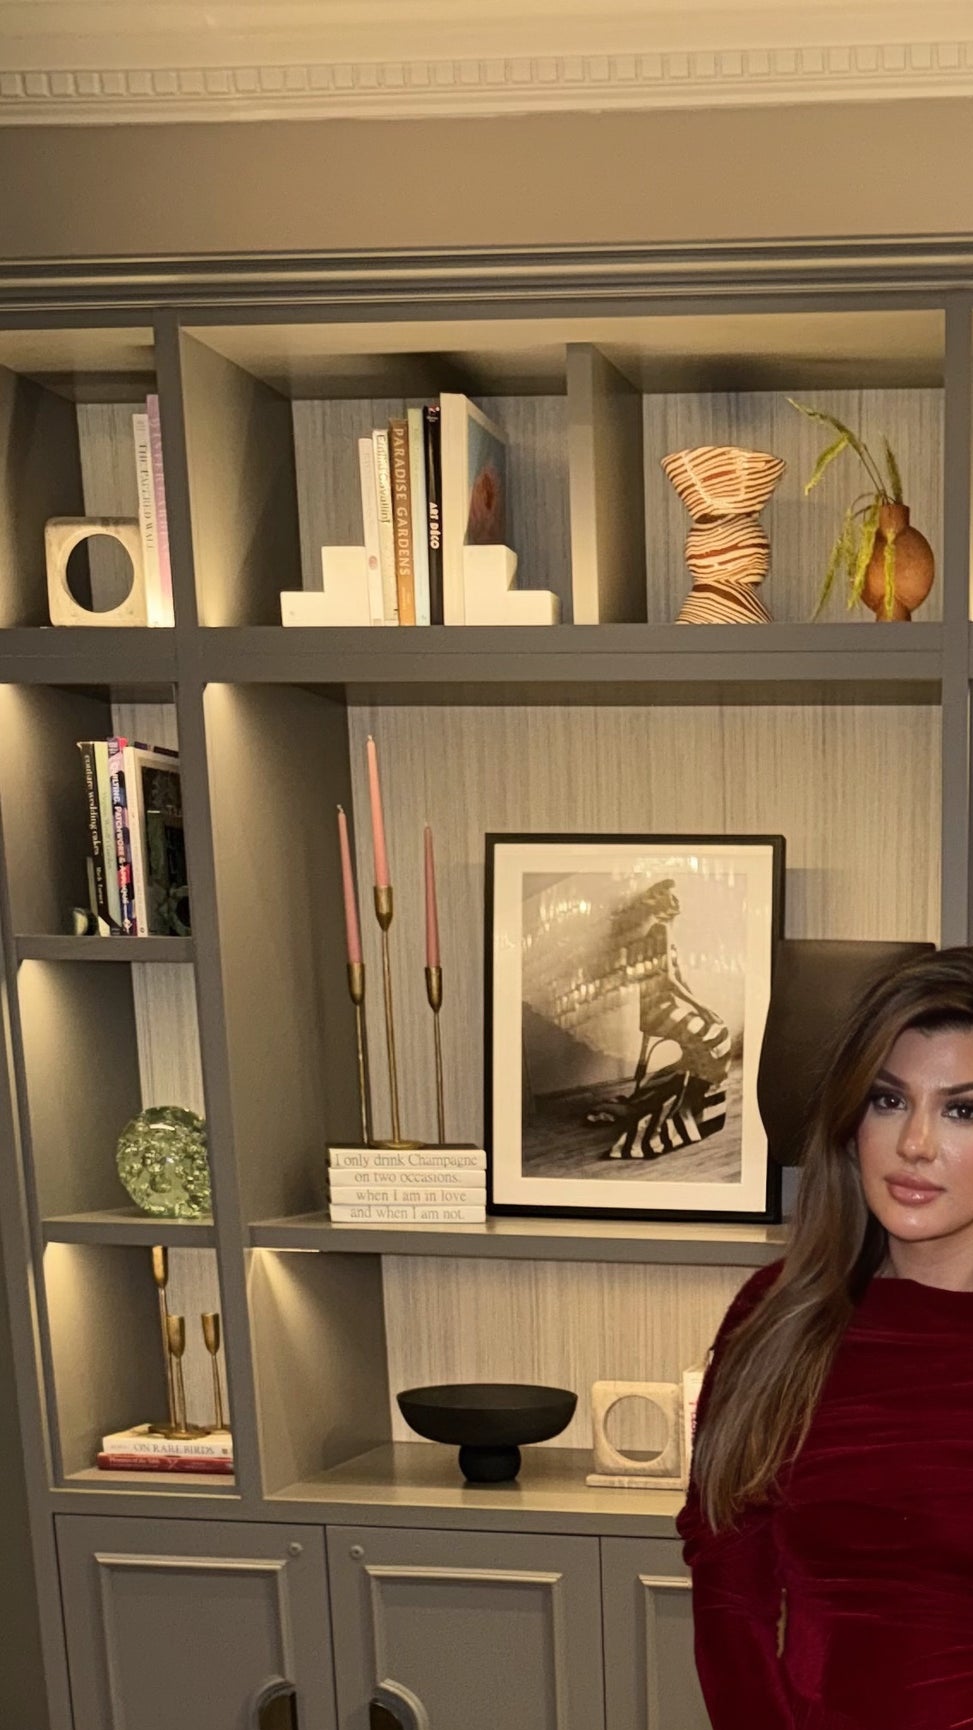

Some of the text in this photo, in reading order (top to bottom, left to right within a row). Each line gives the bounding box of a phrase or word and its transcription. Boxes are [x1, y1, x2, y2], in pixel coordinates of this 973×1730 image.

[139, 444, 148, 463] THE
[392, 428, 411, 576] PARADISE GARDENS
[429, 502, 439, 520] ART
[88, 791, 98, 830] wedding
[114, 806, 125, 856] PATCHWORK
[92, 831, 101, 856] cakes
[335, 1154, 478, 1168] I only drink Champagne
[354, 1173, 370, 1182] on
[374, 1172, 396, 1182] two
[356, 1190, 467, 1201] when I am in love
[350, 1206, 372, 1218] and
[376, 1206, 408, 1219] when
[412, 1207, 416, 1219] I
[421, 1210, 439, 1219] am
